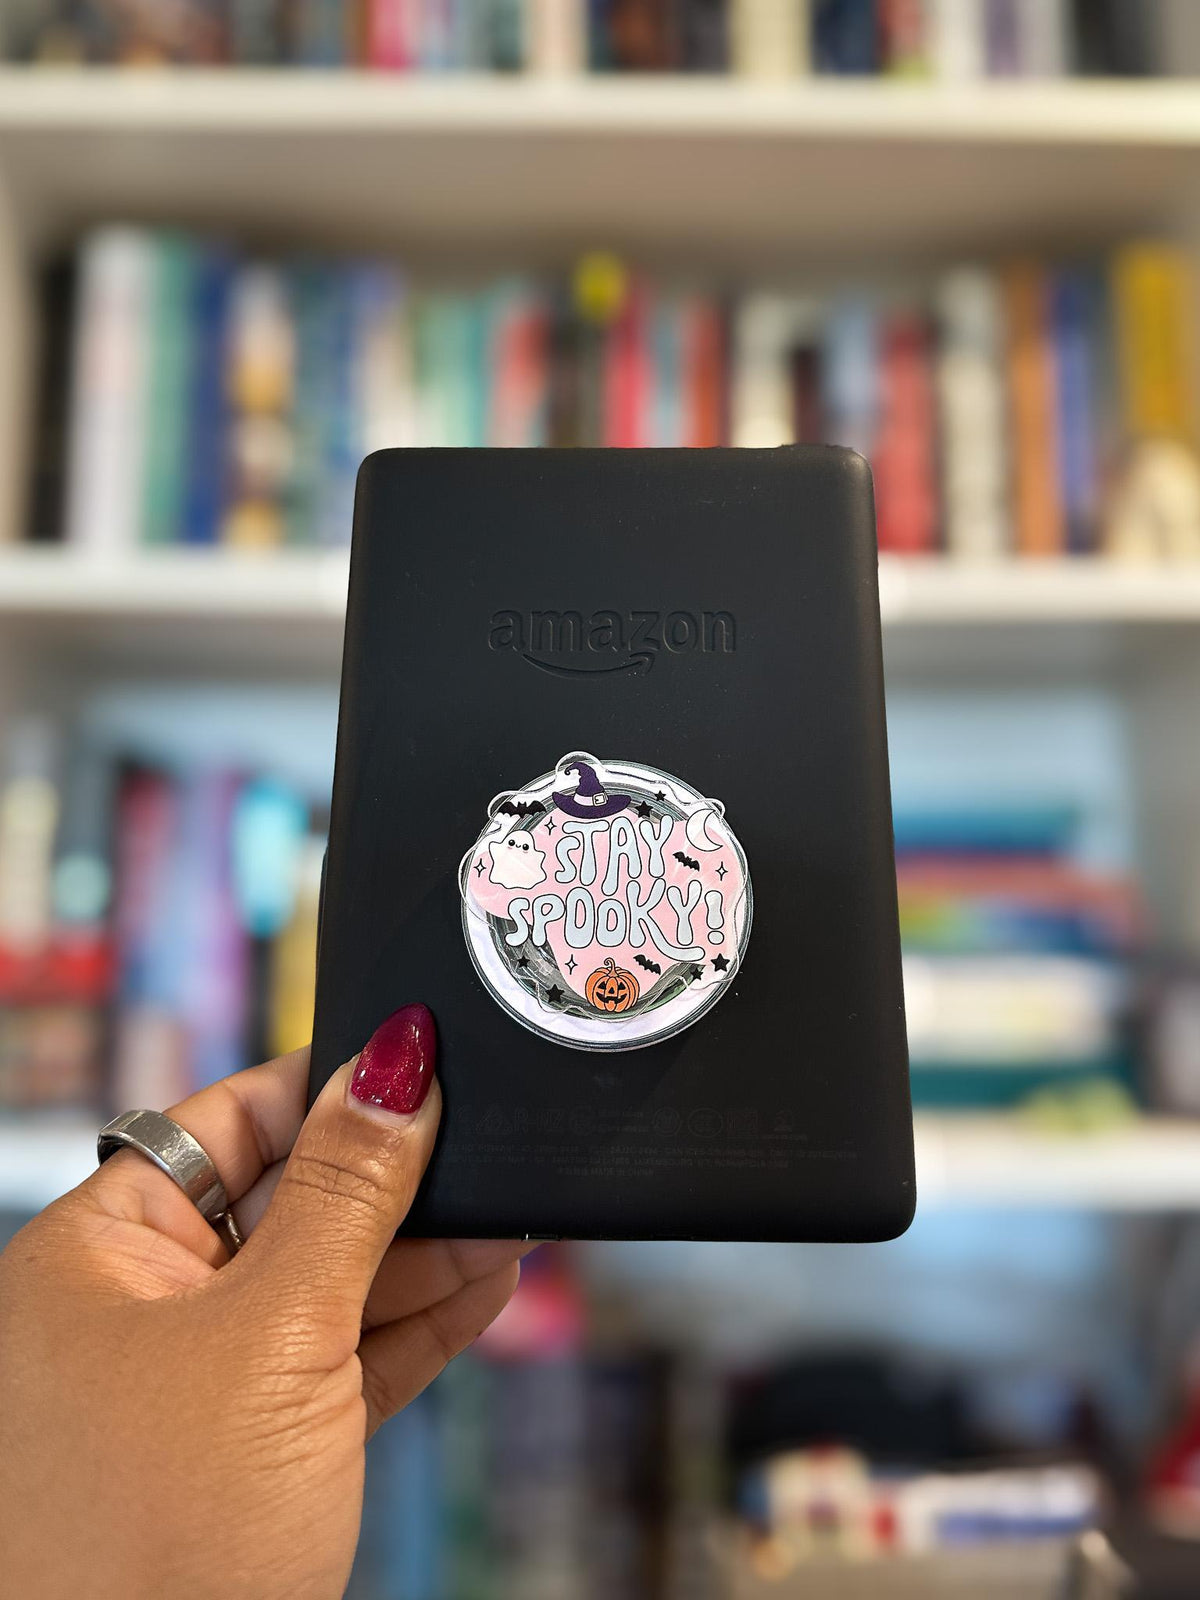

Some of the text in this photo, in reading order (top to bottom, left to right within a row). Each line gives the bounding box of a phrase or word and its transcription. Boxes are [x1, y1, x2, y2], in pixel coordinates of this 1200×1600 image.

[488, 610, 736, 652] amazon
[555, 814, 674, 896] STAY
[505, 877, 725, 962] SPOOKY!
